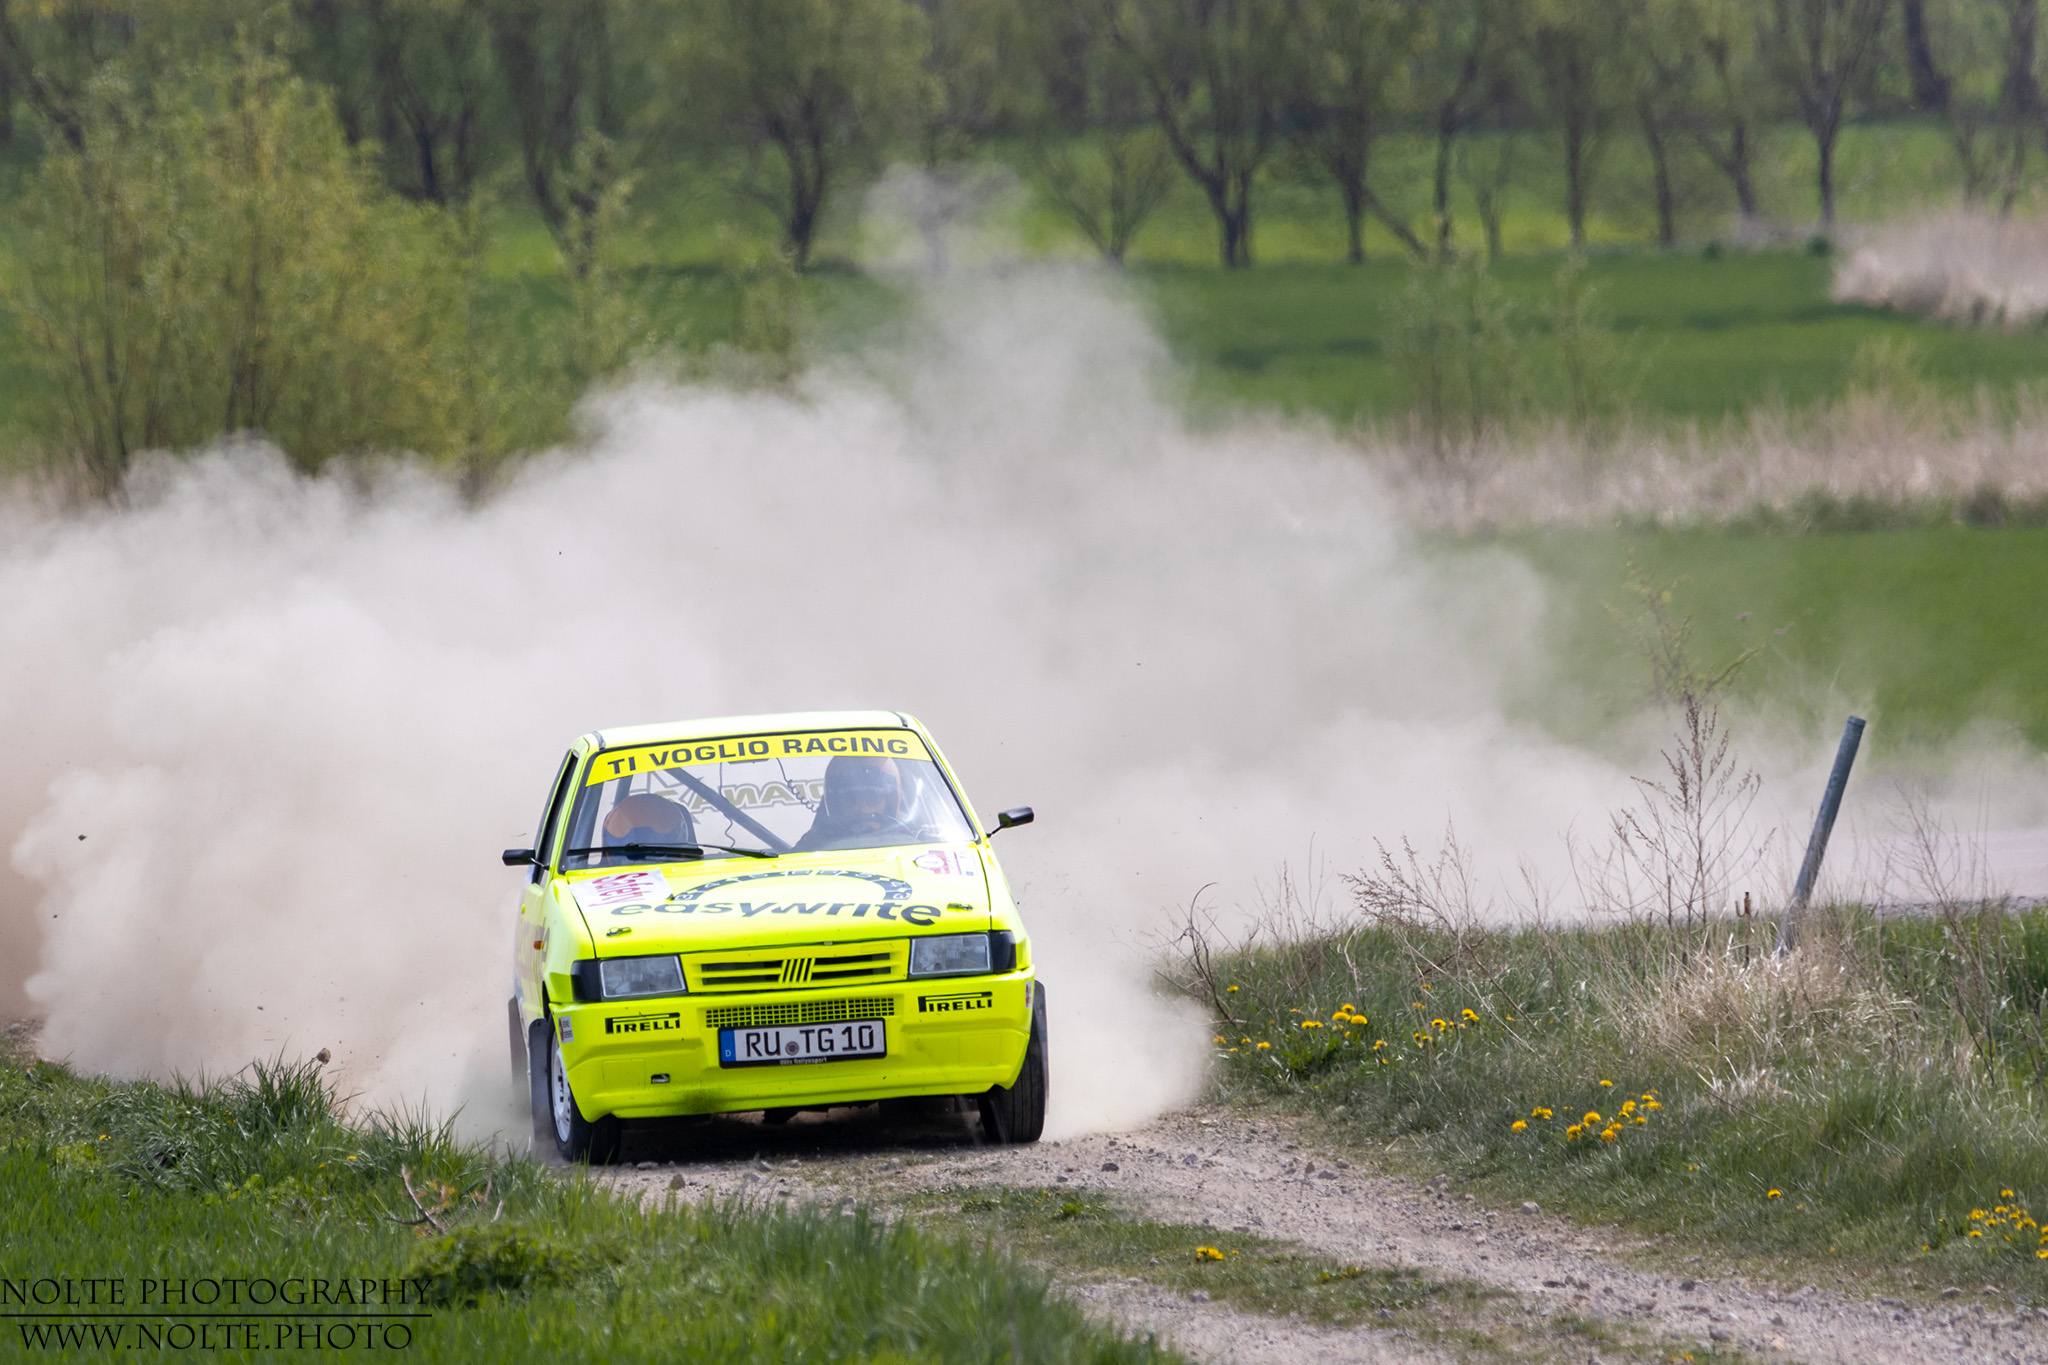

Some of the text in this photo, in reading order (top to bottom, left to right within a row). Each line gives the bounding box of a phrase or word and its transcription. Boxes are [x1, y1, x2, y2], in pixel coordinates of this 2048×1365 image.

[607, 737, 909, 775] TI VOGLIO RACING
[610, 902, 942, 926] easywrite
[918, 991, 993, 1013] PIRELLI
[604, 1012, 680, 1034] PIRELLI
[745, 1025, 874, 1058] RU TG 10
[725, 1050, 732, 1058] D
